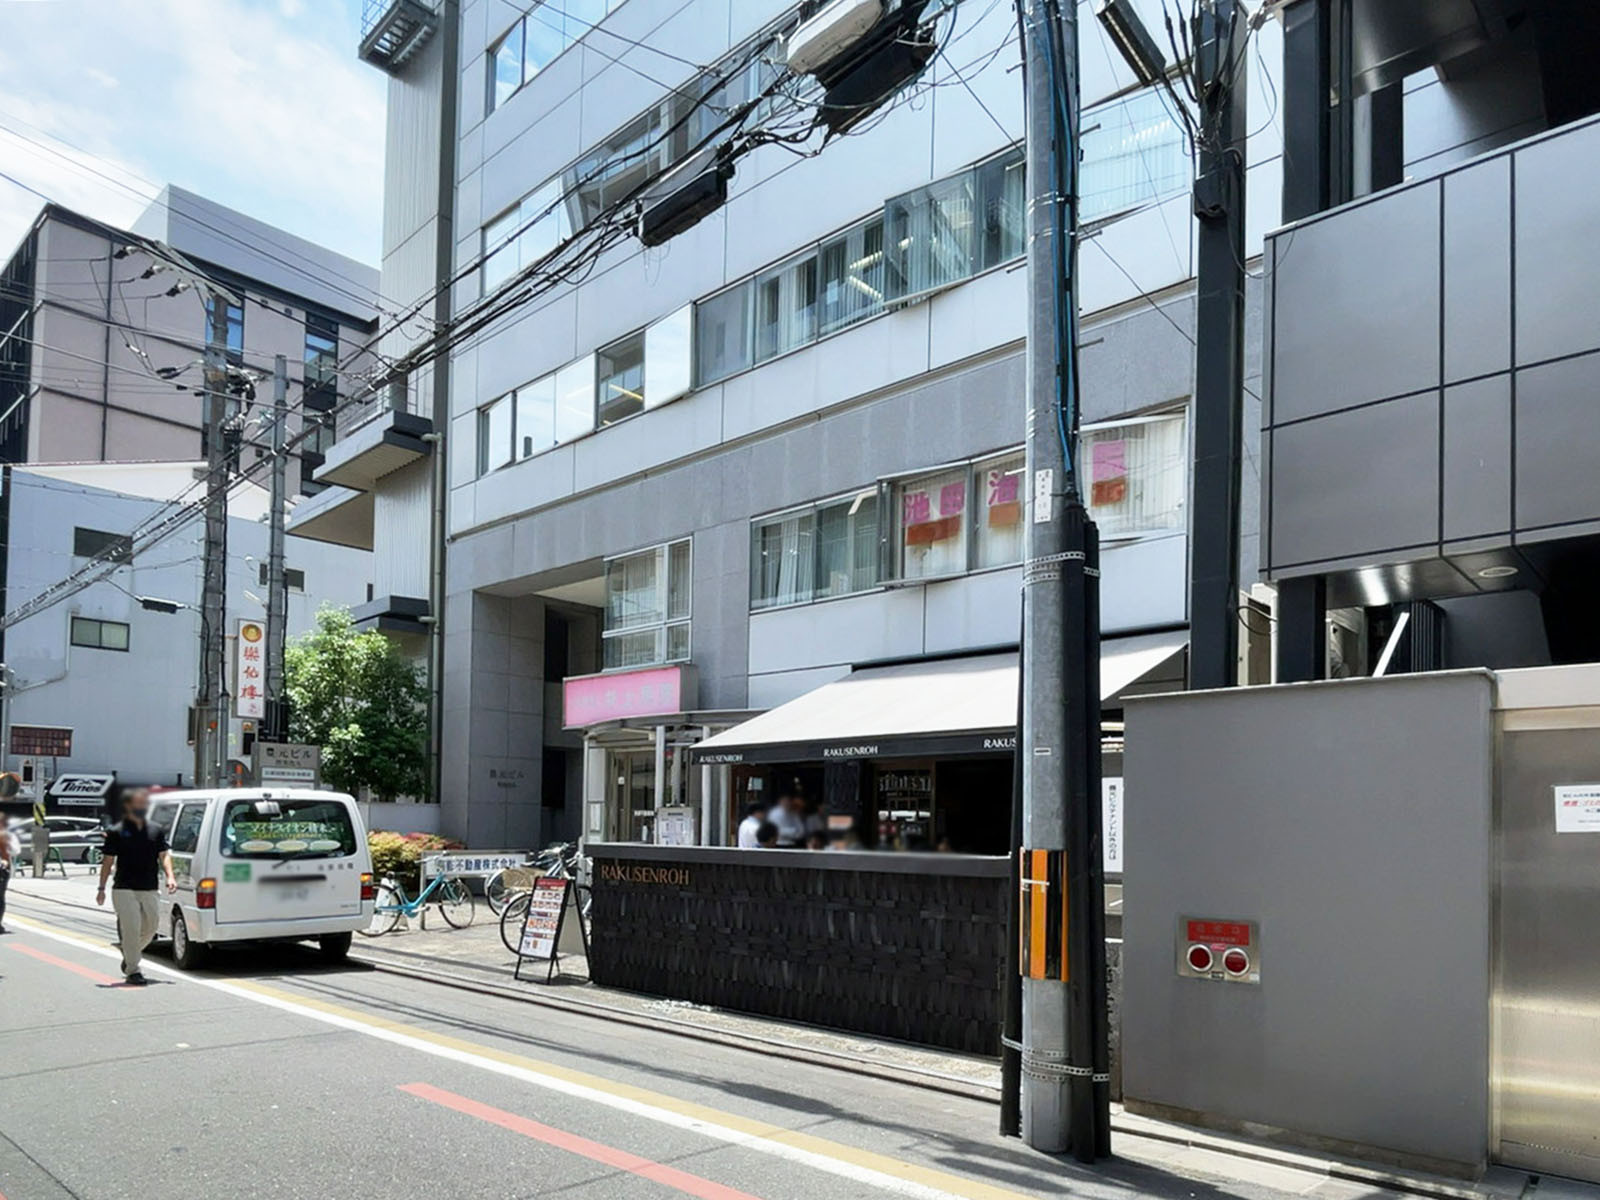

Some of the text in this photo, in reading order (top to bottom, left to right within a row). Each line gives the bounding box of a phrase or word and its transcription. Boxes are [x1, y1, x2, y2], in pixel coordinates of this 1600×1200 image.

[699, 753, 744, 764] RAKUSENROH
[823, 745, 879, 758] RAKUSENROH
[60, 778, 104, 793] Times
[600, 864, 690, 886] RAKUSENROH
